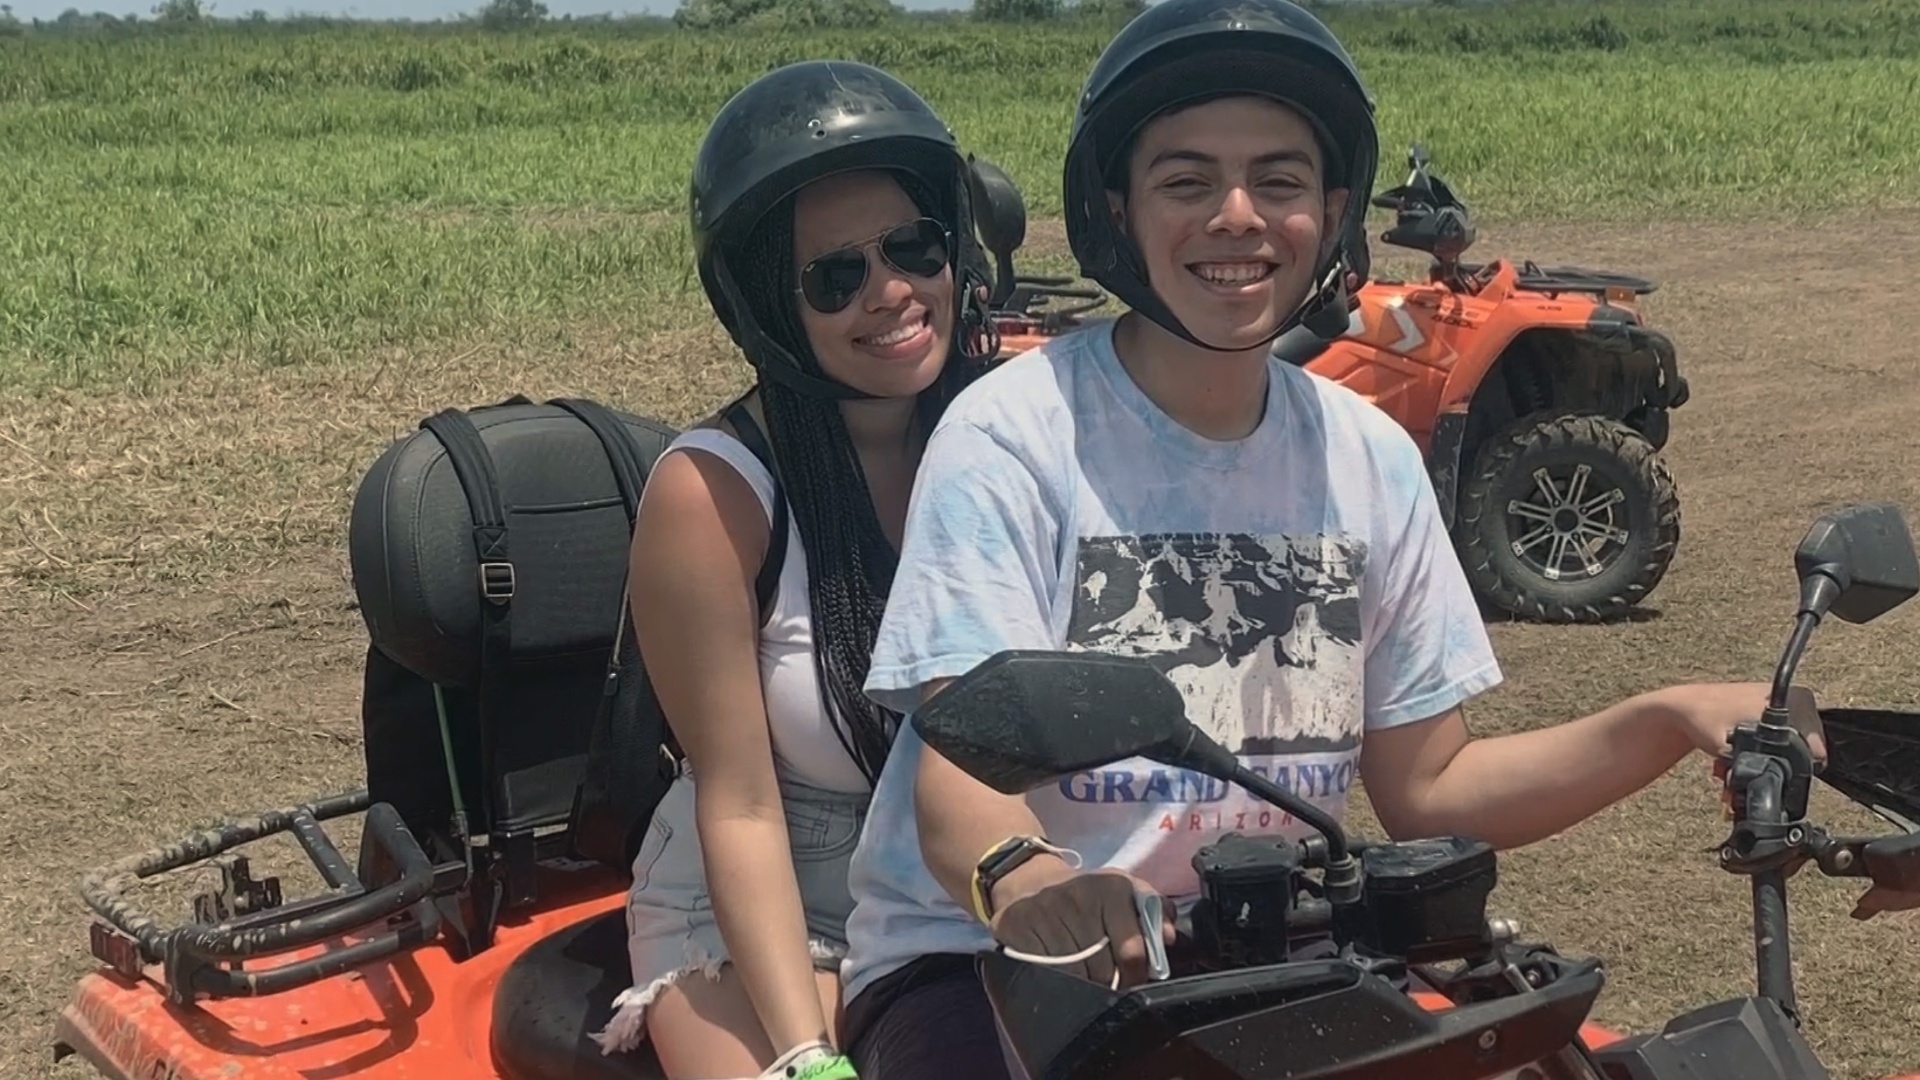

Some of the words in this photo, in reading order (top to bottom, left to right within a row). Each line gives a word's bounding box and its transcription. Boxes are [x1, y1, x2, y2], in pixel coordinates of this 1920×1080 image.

[1059, 769, 1230, 803] GRAND
[1247, 758, 1358, 801] CANYO
[1159, 811, 1293, 830] ARIZON
